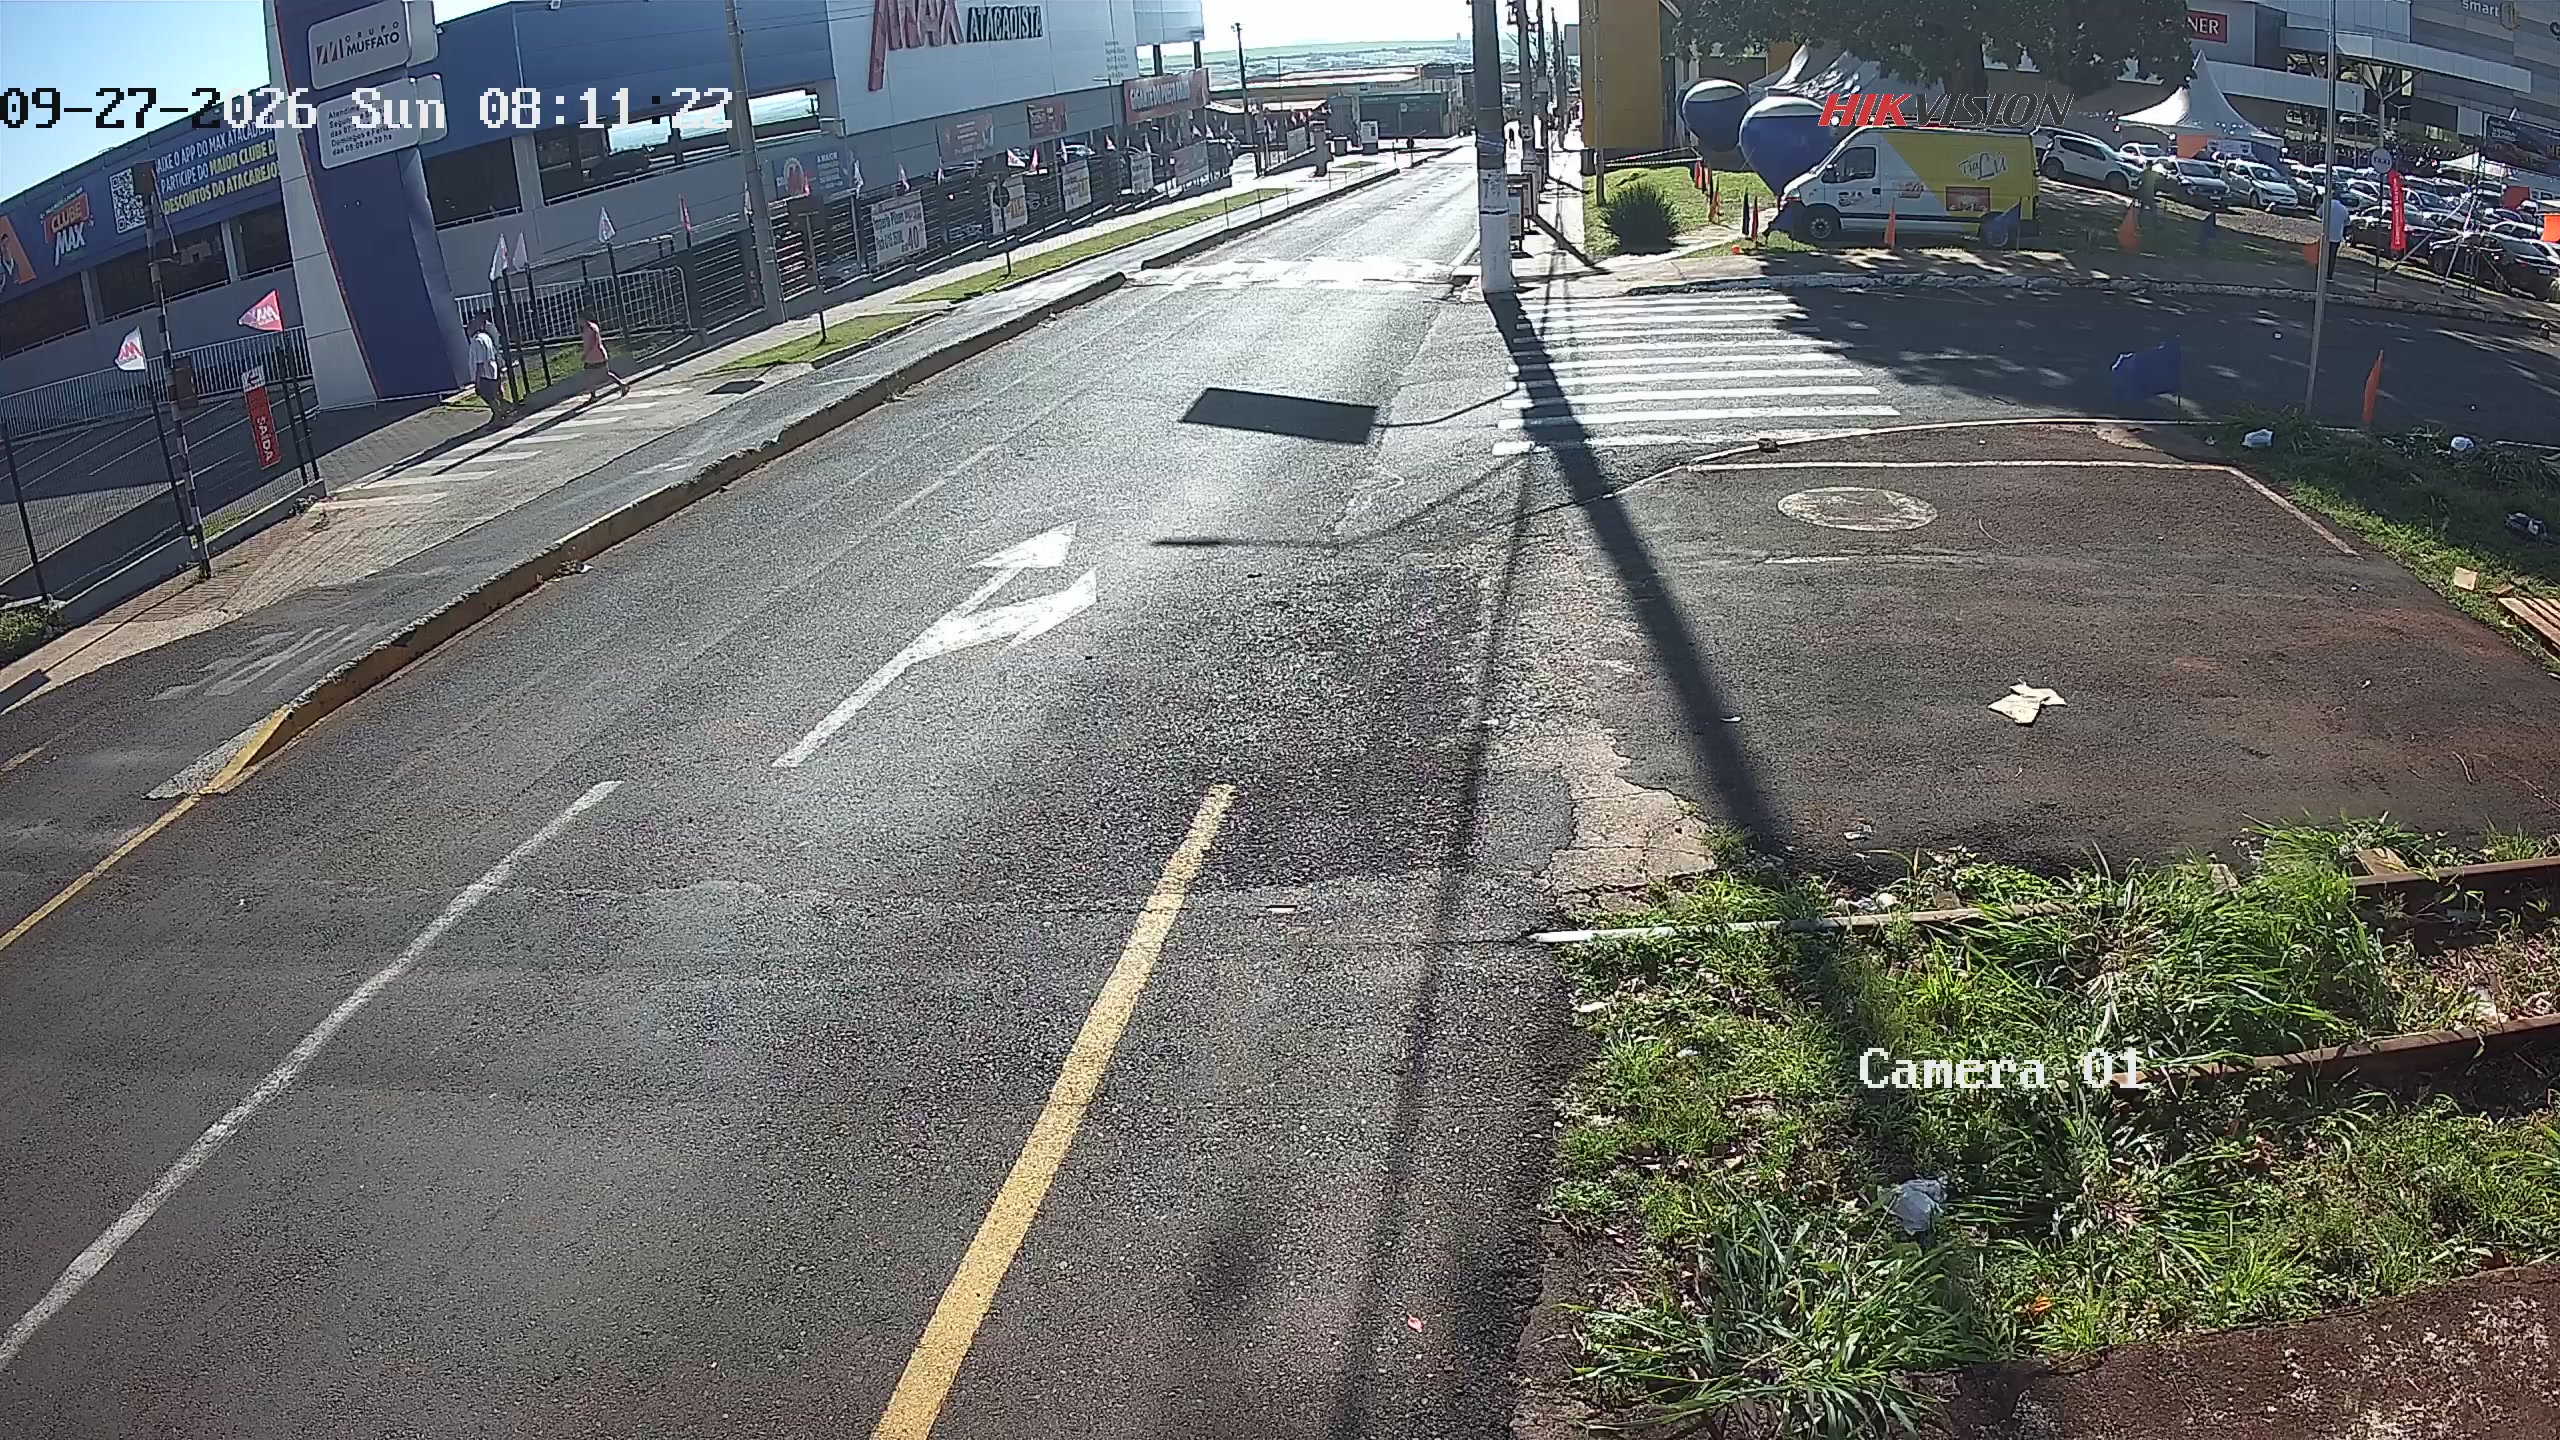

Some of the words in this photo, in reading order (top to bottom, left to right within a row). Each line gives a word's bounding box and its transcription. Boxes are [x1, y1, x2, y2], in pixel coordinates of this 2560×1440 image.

[966, 5, 1044, 43] ATACADISTA
[2462, 0, 2500, 17] smart
[345, 21, 399, 43] GRUPO
[2187, 16, 2219, 35] NER
[346, 31, 400, 56] MUFFATO
[181, 144, 196, 165] APP
[196, 139, 209, 157] DO
[208, 132, 228, 154] MAX
[160, 168, 198, 195] PARTICIPE
[197, 162, 209, 182] DO
[209, 151, 239, 177] MAIOR
[239, 141, 268, 165] CLUBE
[162, 183, 212, 216] DESCONTOS
[211, 179, 226, 199] DO
[51, 201, 83, 234] CLUBE
[55, 221, 87, 267] MAX
[256, 416, 274, 462] SAÍDA
